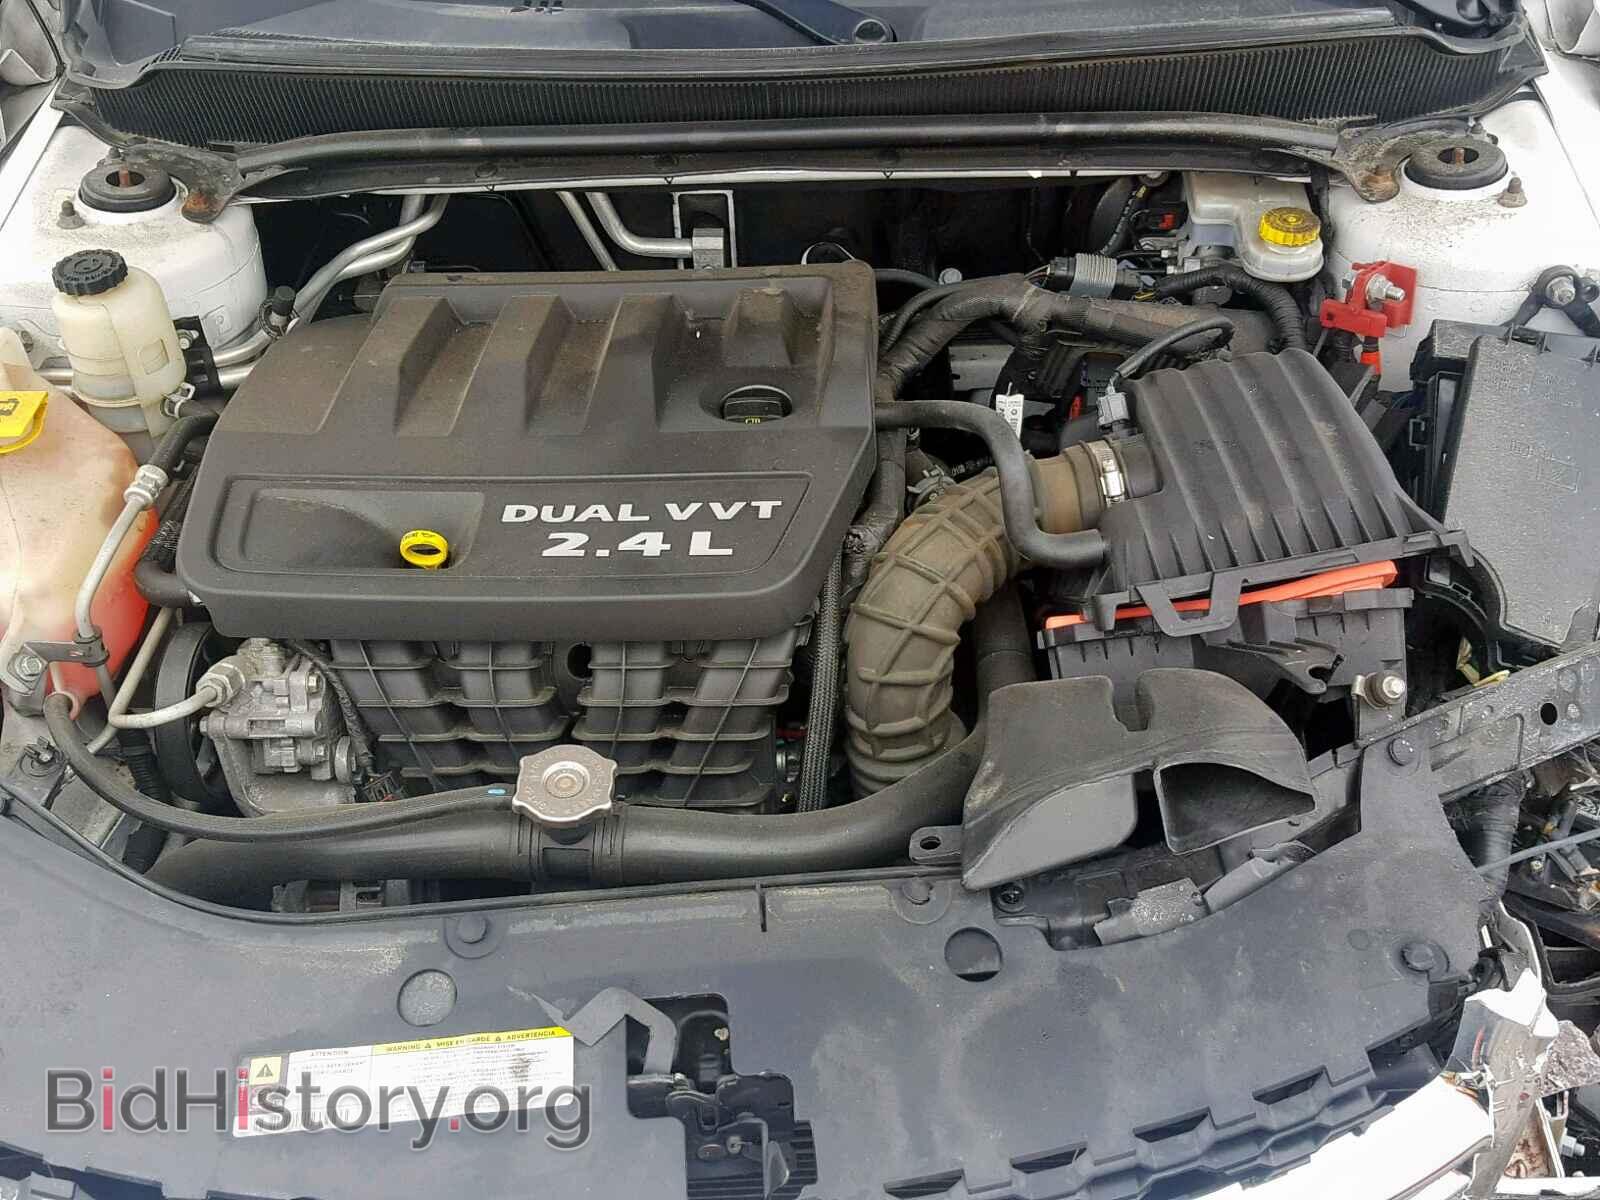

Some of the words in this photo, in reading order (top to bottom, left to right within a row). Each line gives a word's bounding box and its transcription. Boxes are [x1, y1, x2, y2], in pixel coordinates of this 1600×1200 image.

[501, 504, 650, 522] DUAL
[664, 500, 783, 520] VVT
[541, 531, 672, 557] 2.4
[688, 530, 733, 556] L
[386, 1043, 421, 1052] WARNING
